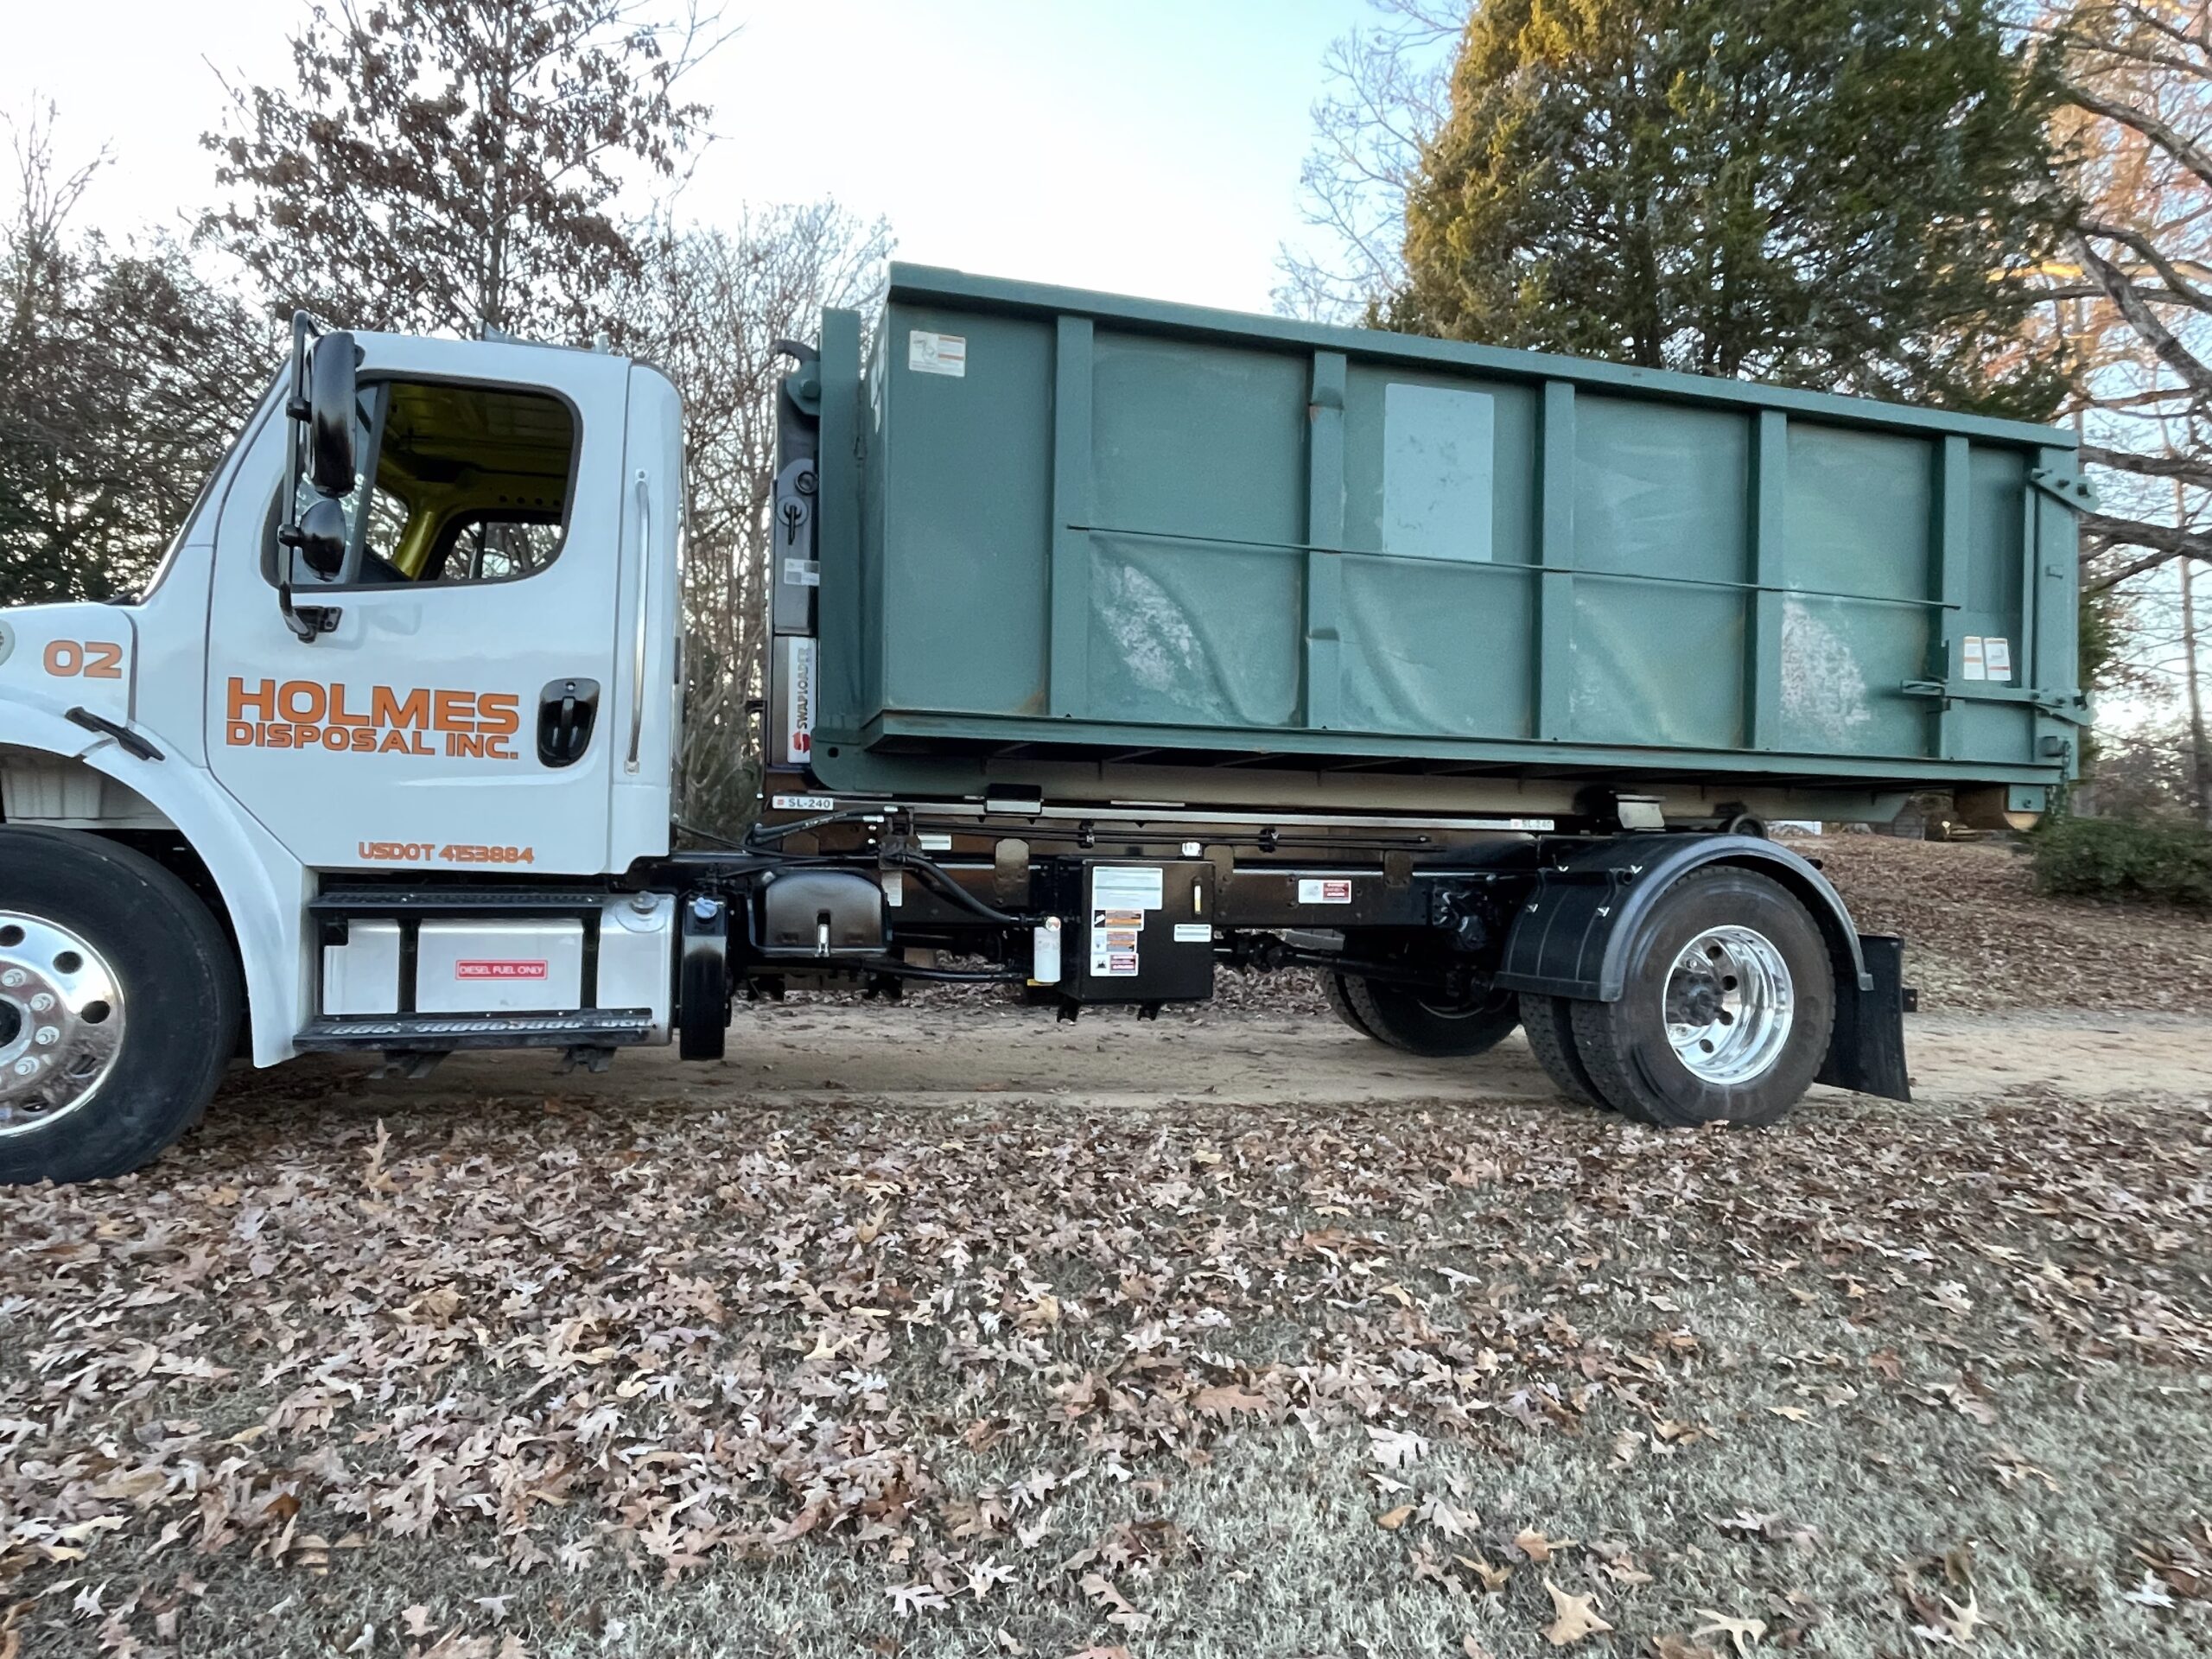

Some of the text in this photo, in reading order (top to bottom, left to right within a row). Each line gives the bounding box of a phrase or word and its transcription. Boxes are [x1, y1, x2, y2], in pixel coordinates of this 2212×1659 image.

[43, 640, 123, 679] 02
[226, 677, 519, 734] HOLMES
[226, 721, 519, 760] DISPOSAL INC.
[788, 798, 830, 809] SL-240
[359, 842, 535, 864] USDOT 4153884
[460, 965, 543, 975] DIESEL FUEL ONLY
